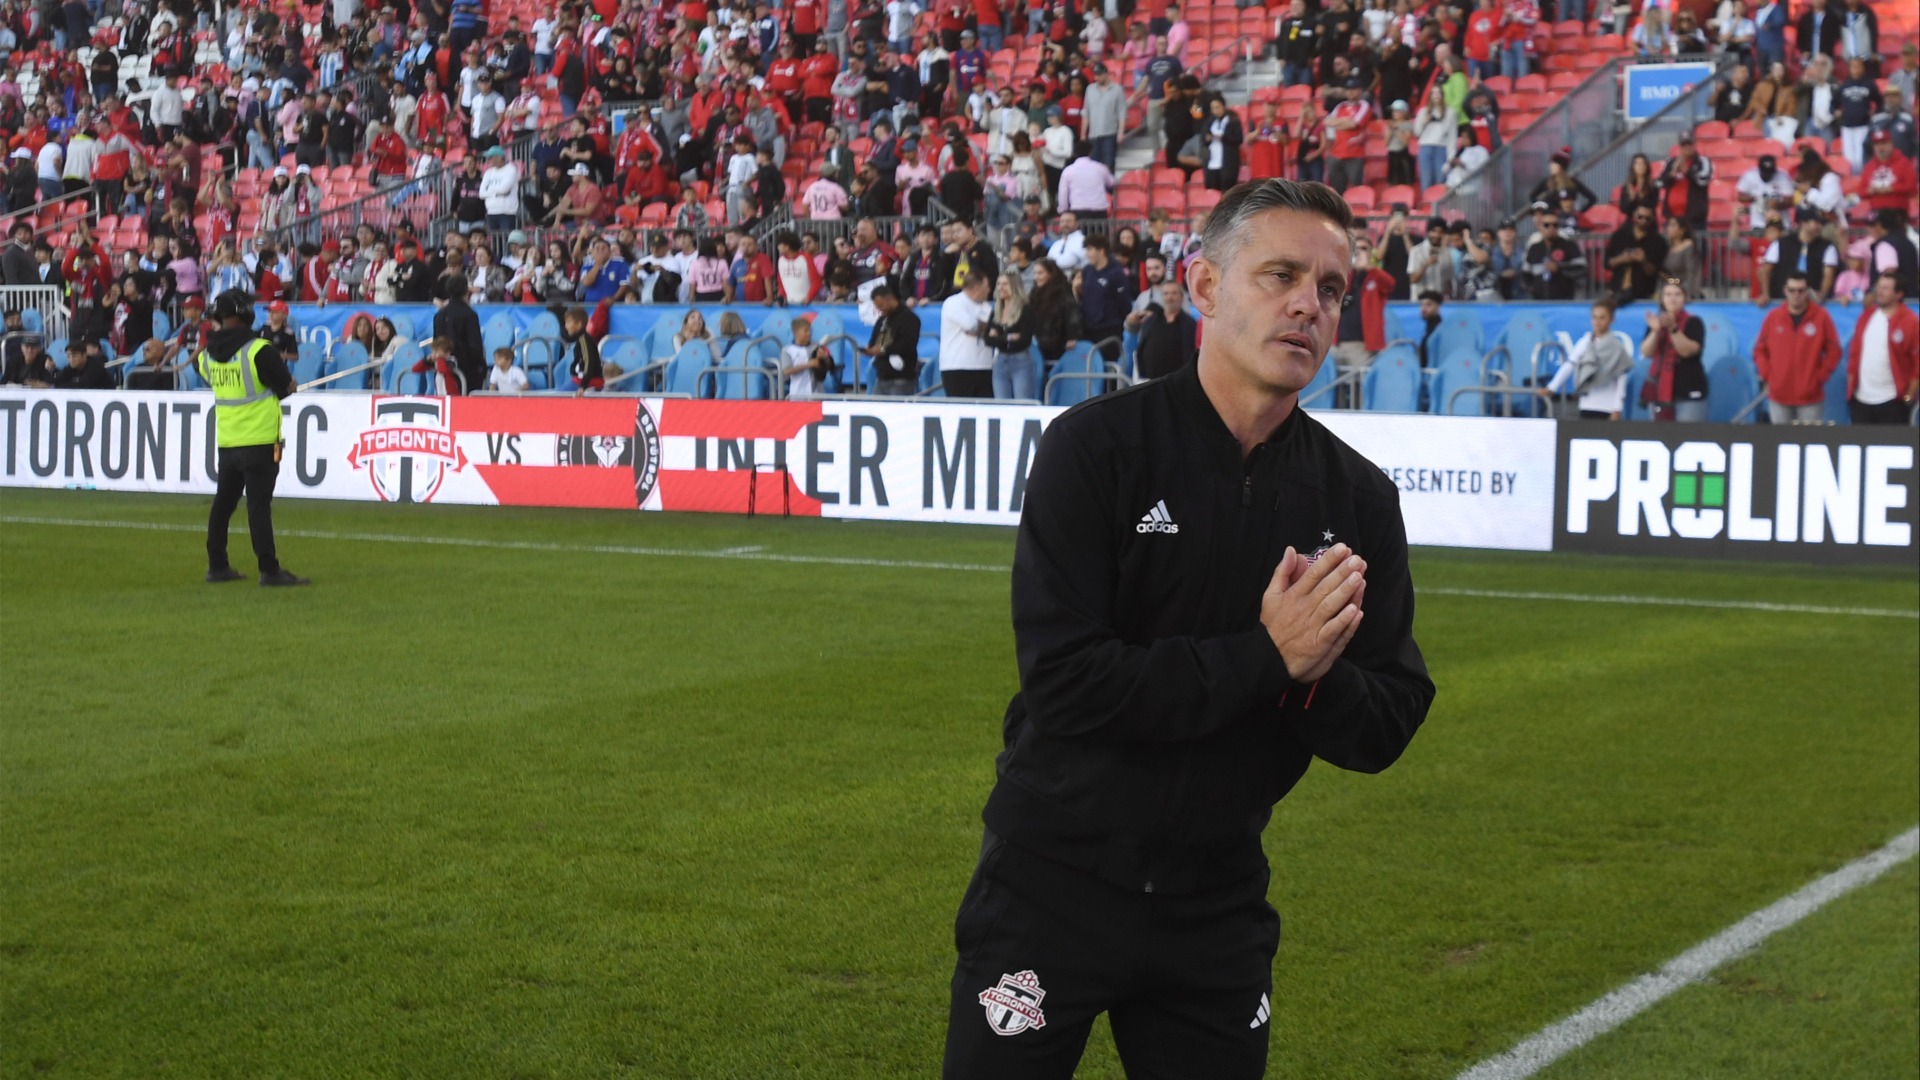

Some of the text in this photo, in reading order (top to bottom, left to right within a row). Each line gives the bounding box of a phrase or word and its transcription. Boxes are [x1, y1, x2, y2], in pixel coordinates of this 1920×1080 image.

[363, 429, 451, 454] TORONTO
[486, 431, 521, 465] VS
[923, 416, 1044, 512] MIA
[1491, 471, 1517, 495] BY
[1566, 437, 1913, 546] PROLINE
[1136, 519, 1179, 534] addas
[989, 991, 1038, 1018] TORONTO
